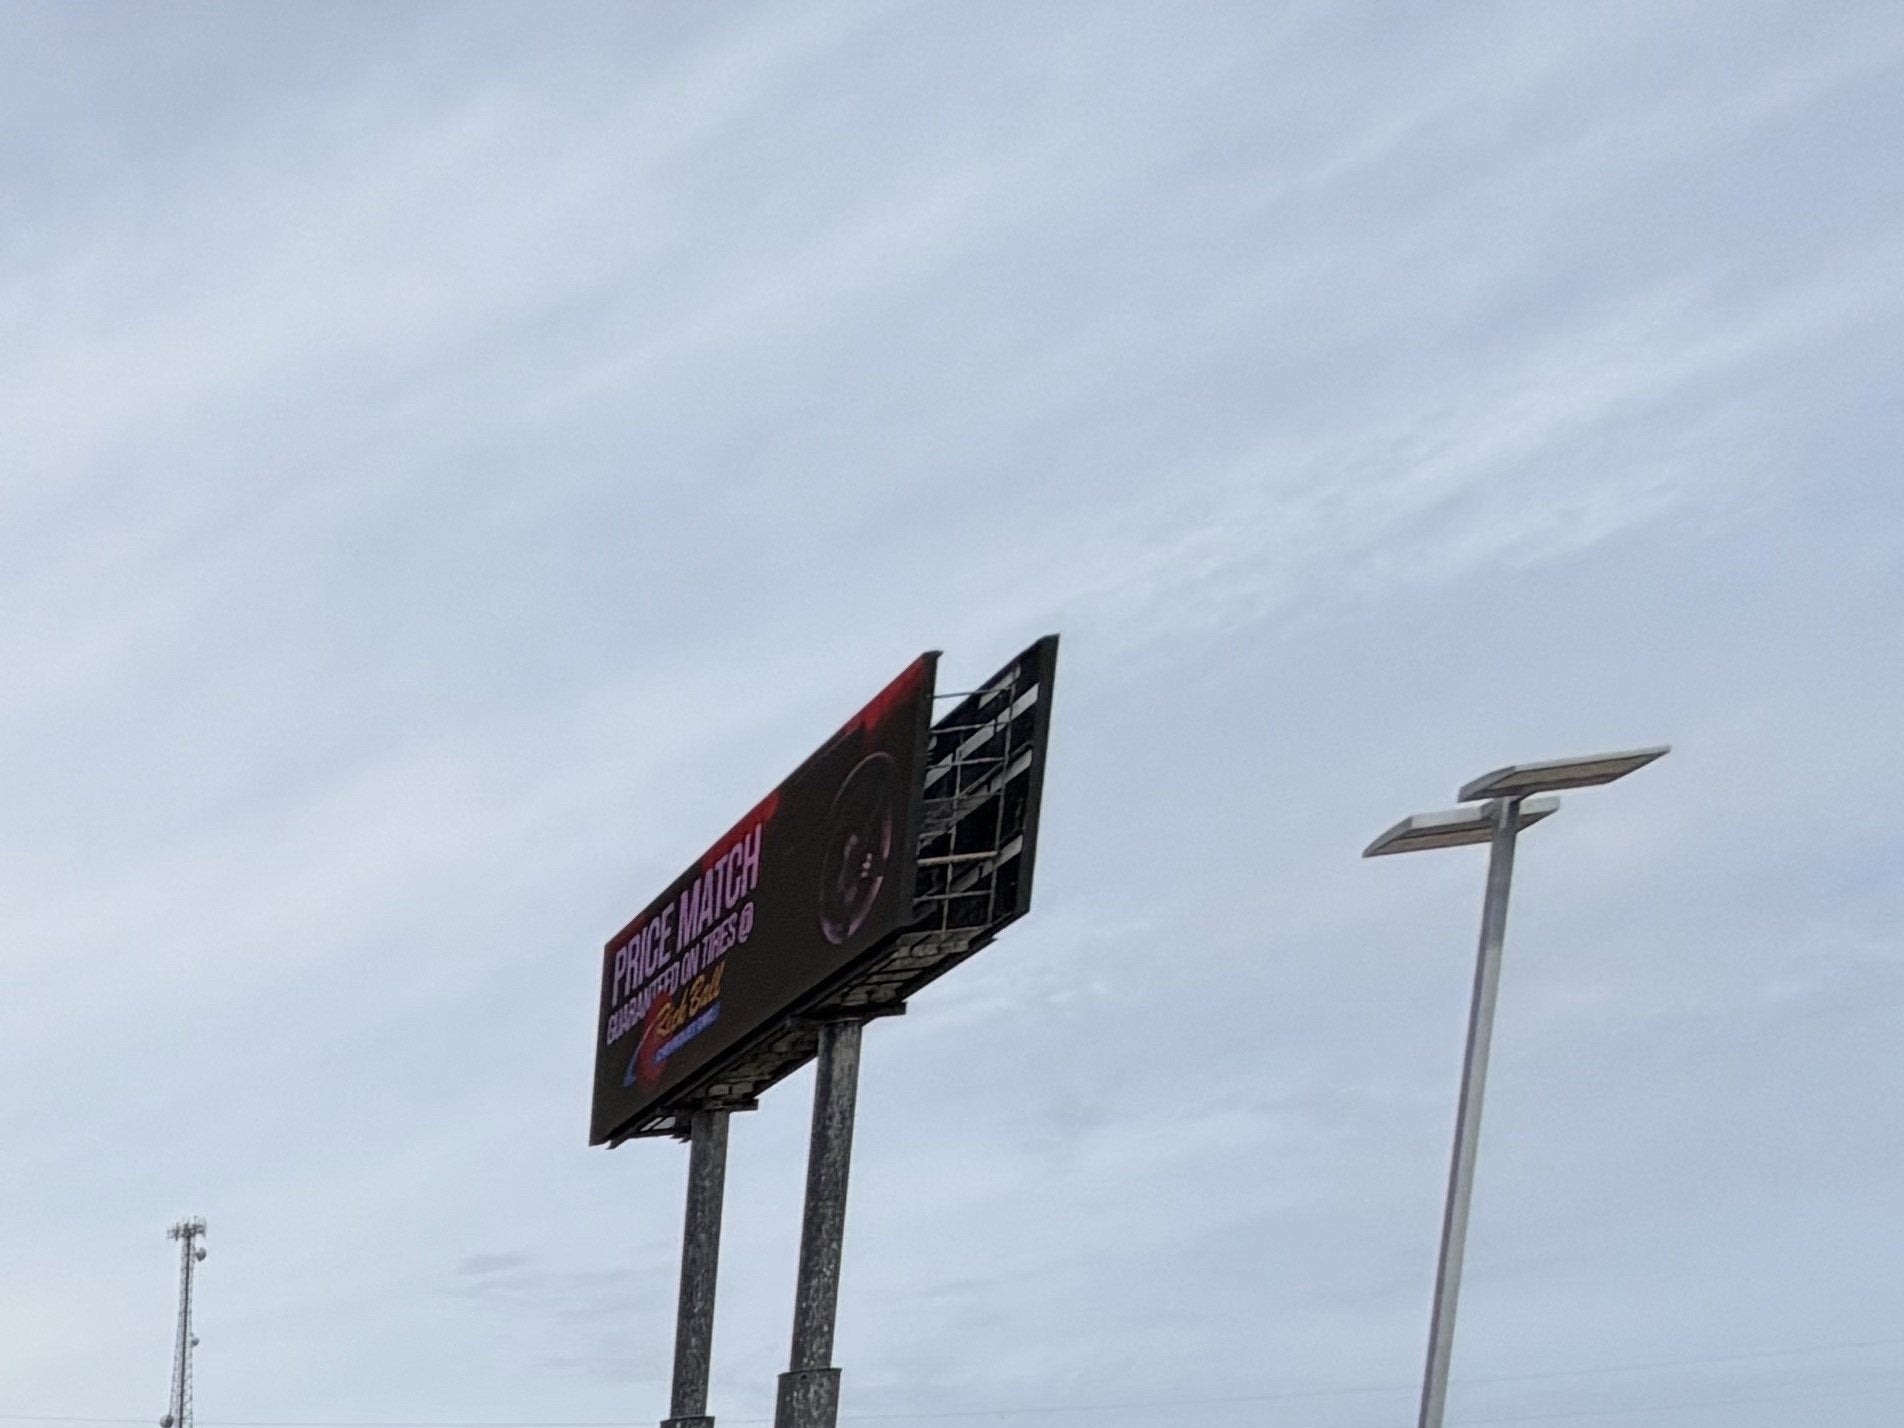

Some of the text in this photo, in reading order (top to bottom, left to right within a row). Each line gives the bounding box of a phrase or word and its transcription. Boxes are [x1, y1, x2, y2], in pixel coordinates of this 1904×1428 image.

[611, 822, 762, 1008] PRICE MATCH
[680, 942, 701, 986] ON
